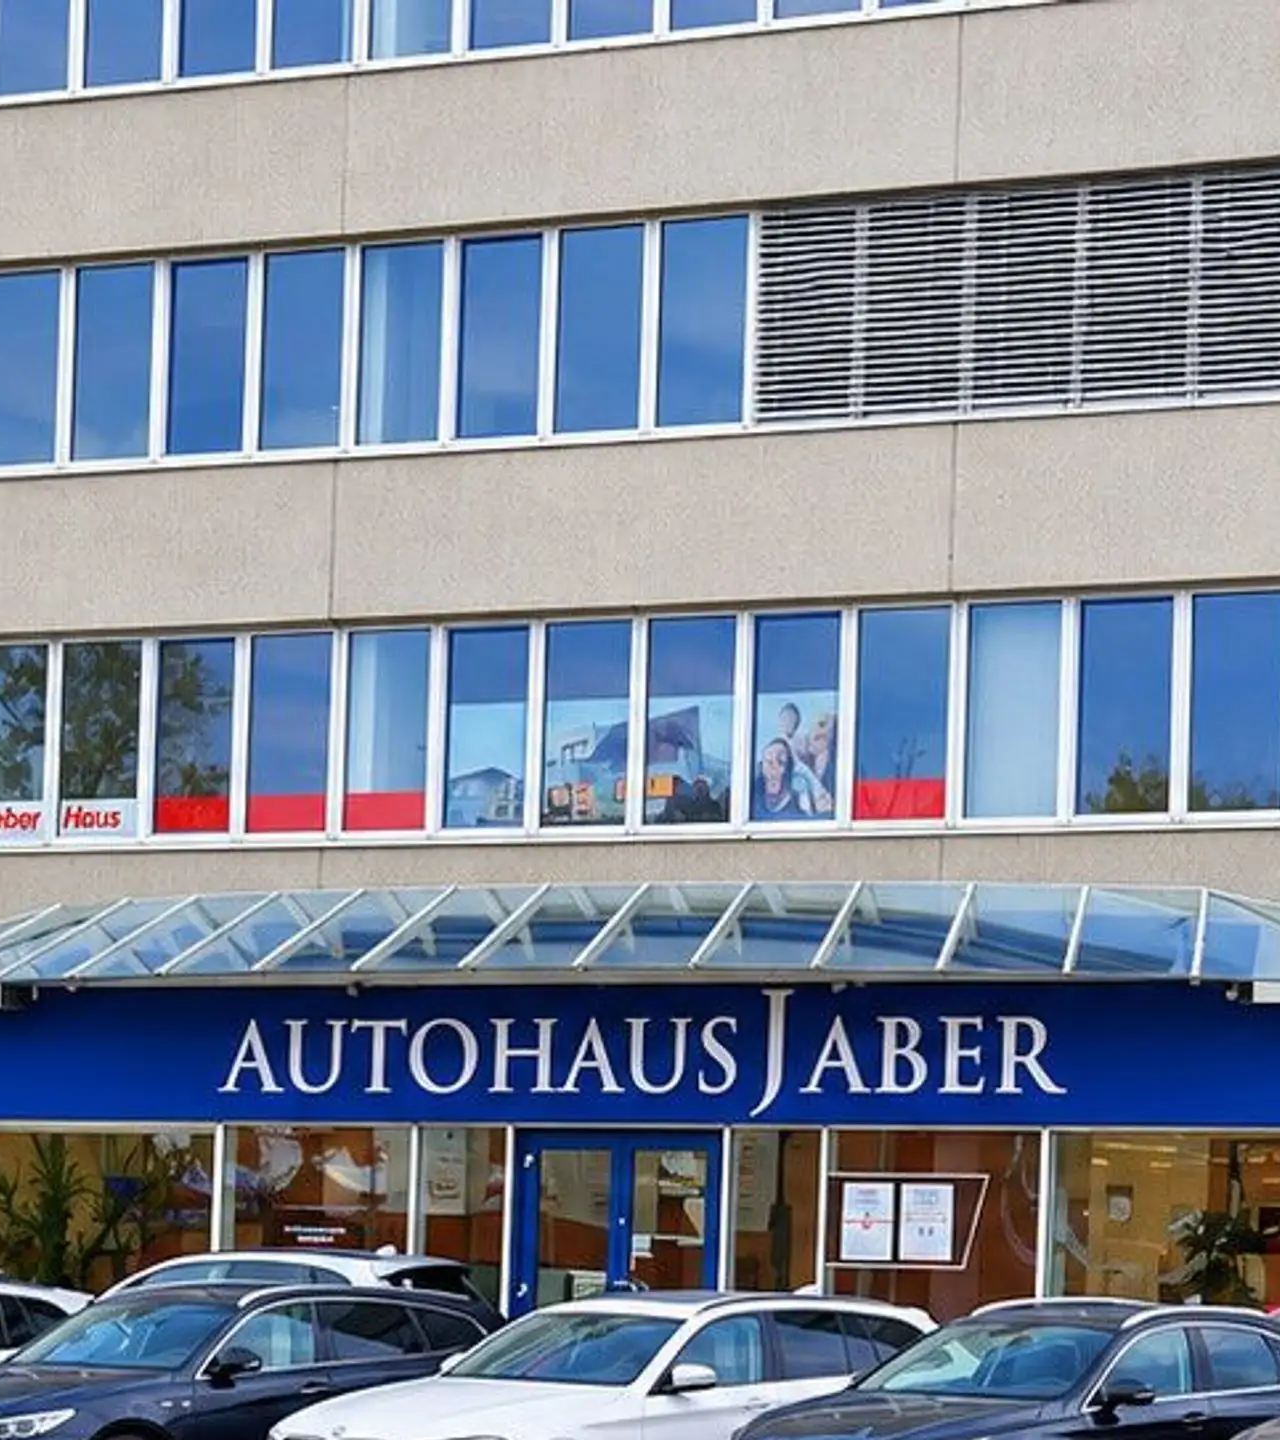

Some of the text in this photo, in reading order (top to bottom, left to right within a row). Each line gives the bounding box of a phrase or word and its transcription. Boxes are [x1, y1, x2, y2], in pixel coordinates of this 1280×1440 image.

[63, 805, 121, 829] Haus
[218, 990, 1067, 1117] AUTOHAUS JABER
